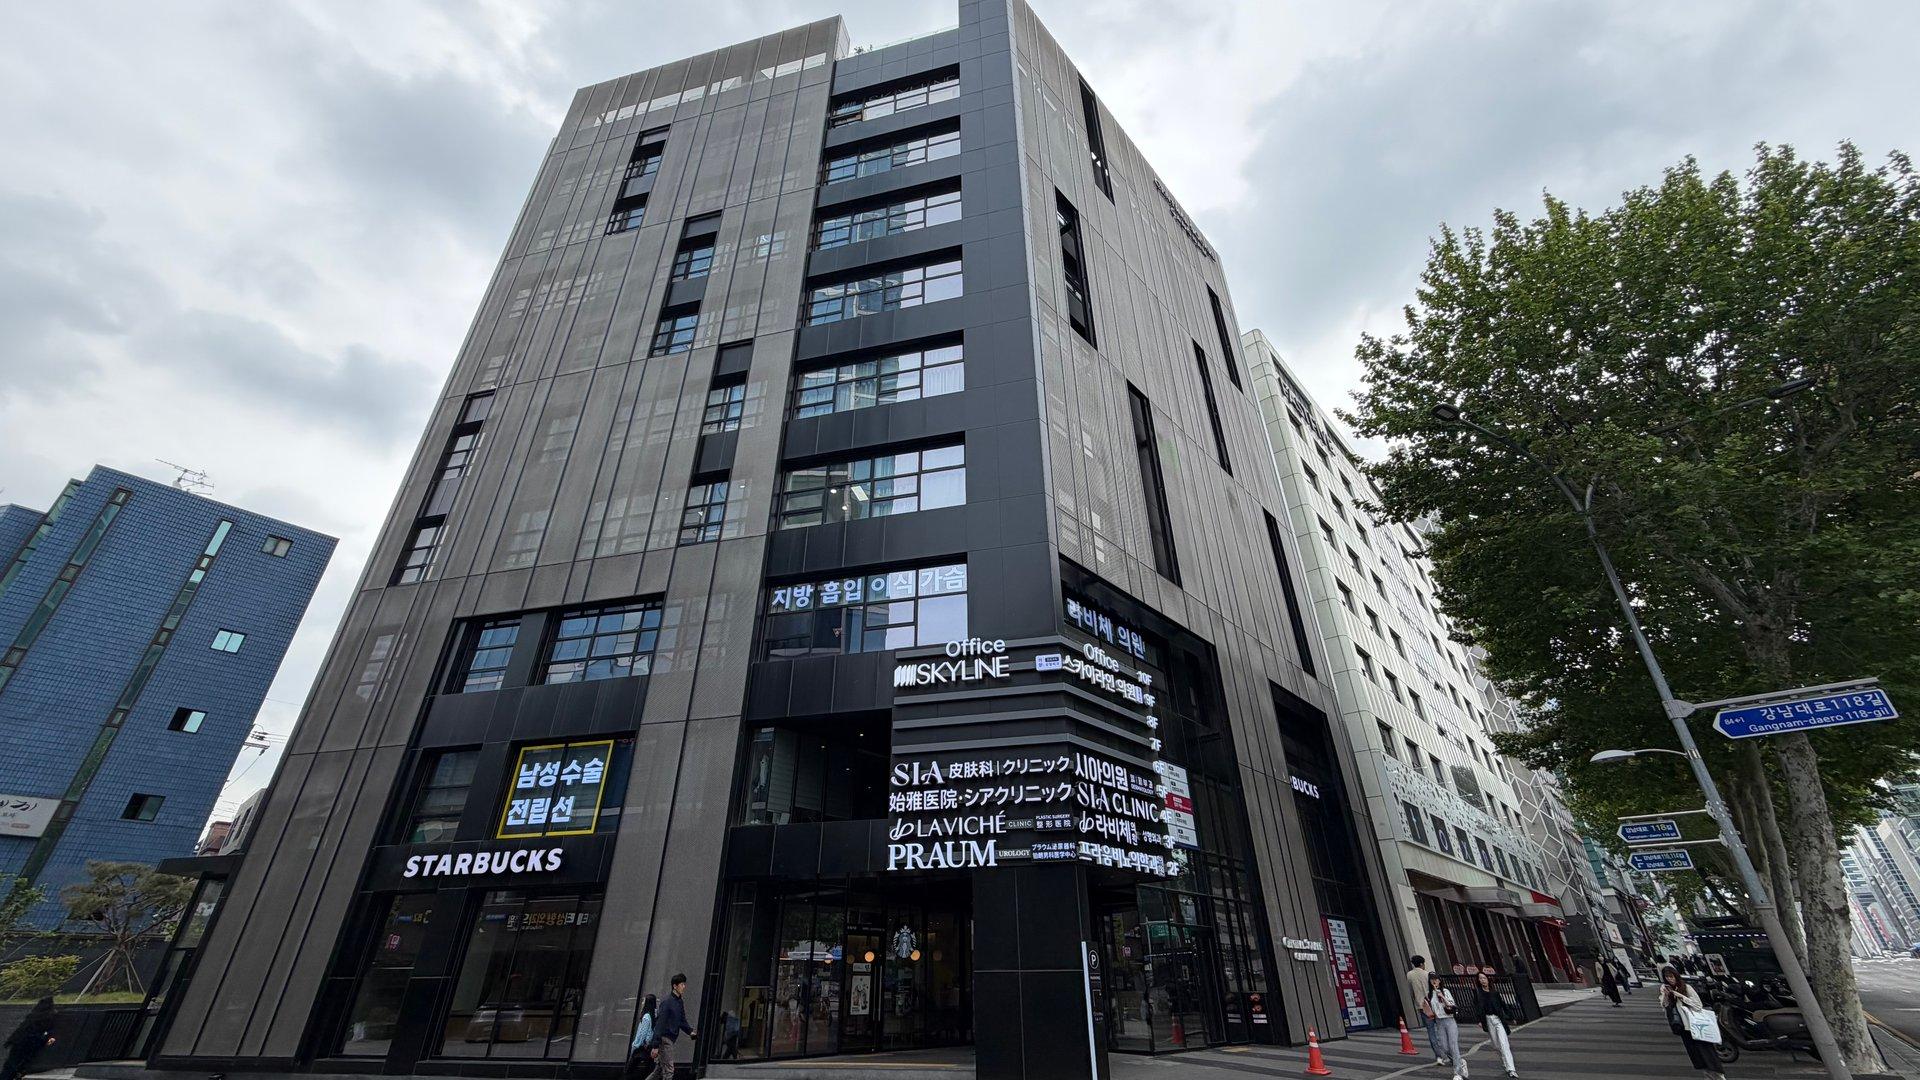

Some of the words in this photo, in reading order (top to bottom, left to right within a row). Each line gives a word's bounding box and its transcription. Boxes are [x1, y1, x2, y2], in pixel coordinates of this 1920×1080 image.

[772, 584, 814, 610] 지방
[820, 578, 862, 604] 흡입
[871, 570, 913, 597] 이식
[921, 567, 965, 592] 가슴
[946, 637, 1006, 658] Office
[1083, 643, 1120, 673] Office
[1118, 626, 1145, 660] 의원
[916, 656, 1010, 685] SKYLINE
[1062, 654, 1116, 693] 스카이라인
[1749, 713, 1844, 733] Gangnam-daero
[1846, 707, 1890, 720] 118-gil
[1759, 692, 1884, 721] 강남대로118길
[516, 757, 605, 789] 남성수술
[890, 761, 945, 787] SIA
[1003, 756, 1070, 775] クリニック
[1075, 752, 1129, 792] 시아의원
[506, 795, 575, 826] 전립선
[1076, 781, 1111, 813] SIA
[1112, 792, 1160, 823] CLINIC
[917, 810, 1007, 838] LAVICHÉ
[1008, 820, 1032, 828] CLINIC
[1095, 814, 1132, 845] 라비체
[403, 847, 563, 878] STARBUCKS
[886, 839, 998, 871] PRAUM
[998, 849, 1031, 858] UROLOGY
[1166, 861, 1180, 877] 2F
